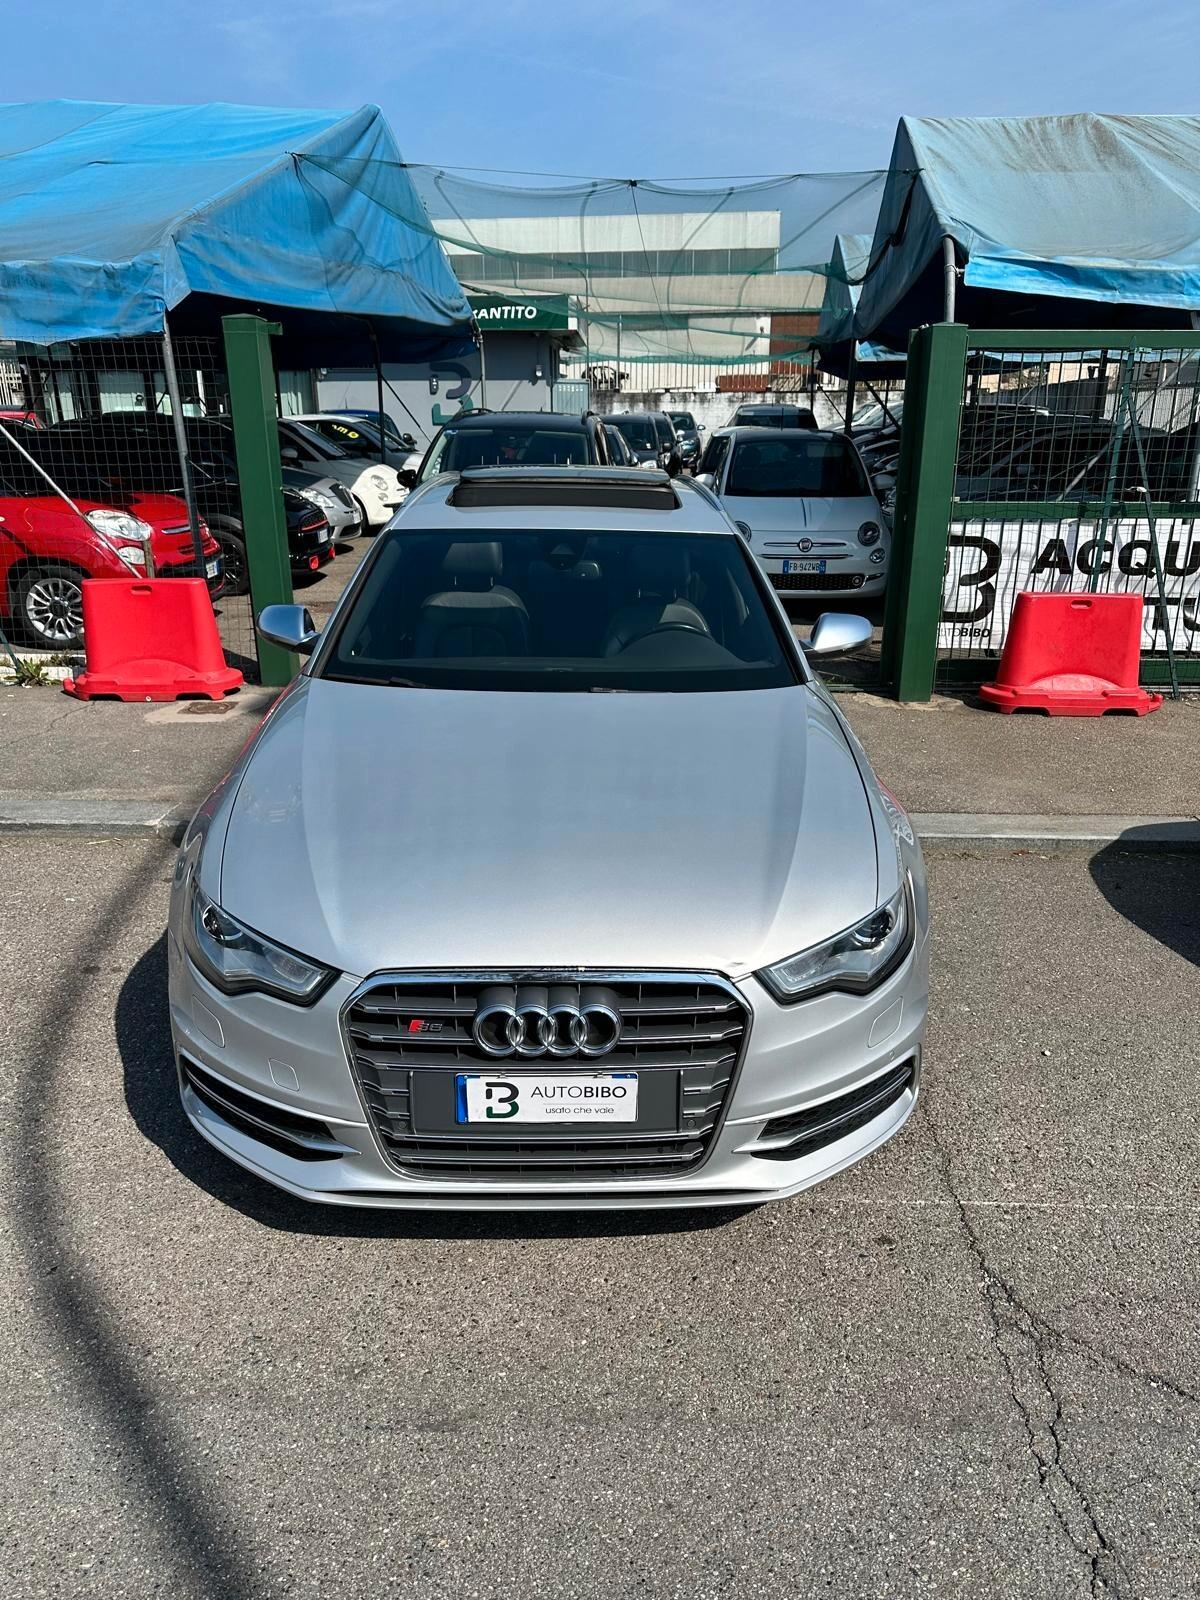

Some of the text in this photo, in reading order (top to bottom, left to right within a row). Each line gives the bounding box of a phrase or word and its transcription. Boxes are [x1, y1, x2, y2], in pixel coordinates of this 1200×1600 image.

[938, 627, 990, 637] UTOBIBO
[530, 1086, 627, 1098] AUTOBIBO
[573, 1106, 592, 1114] che
[594, 1106, 614, 1114] vale
